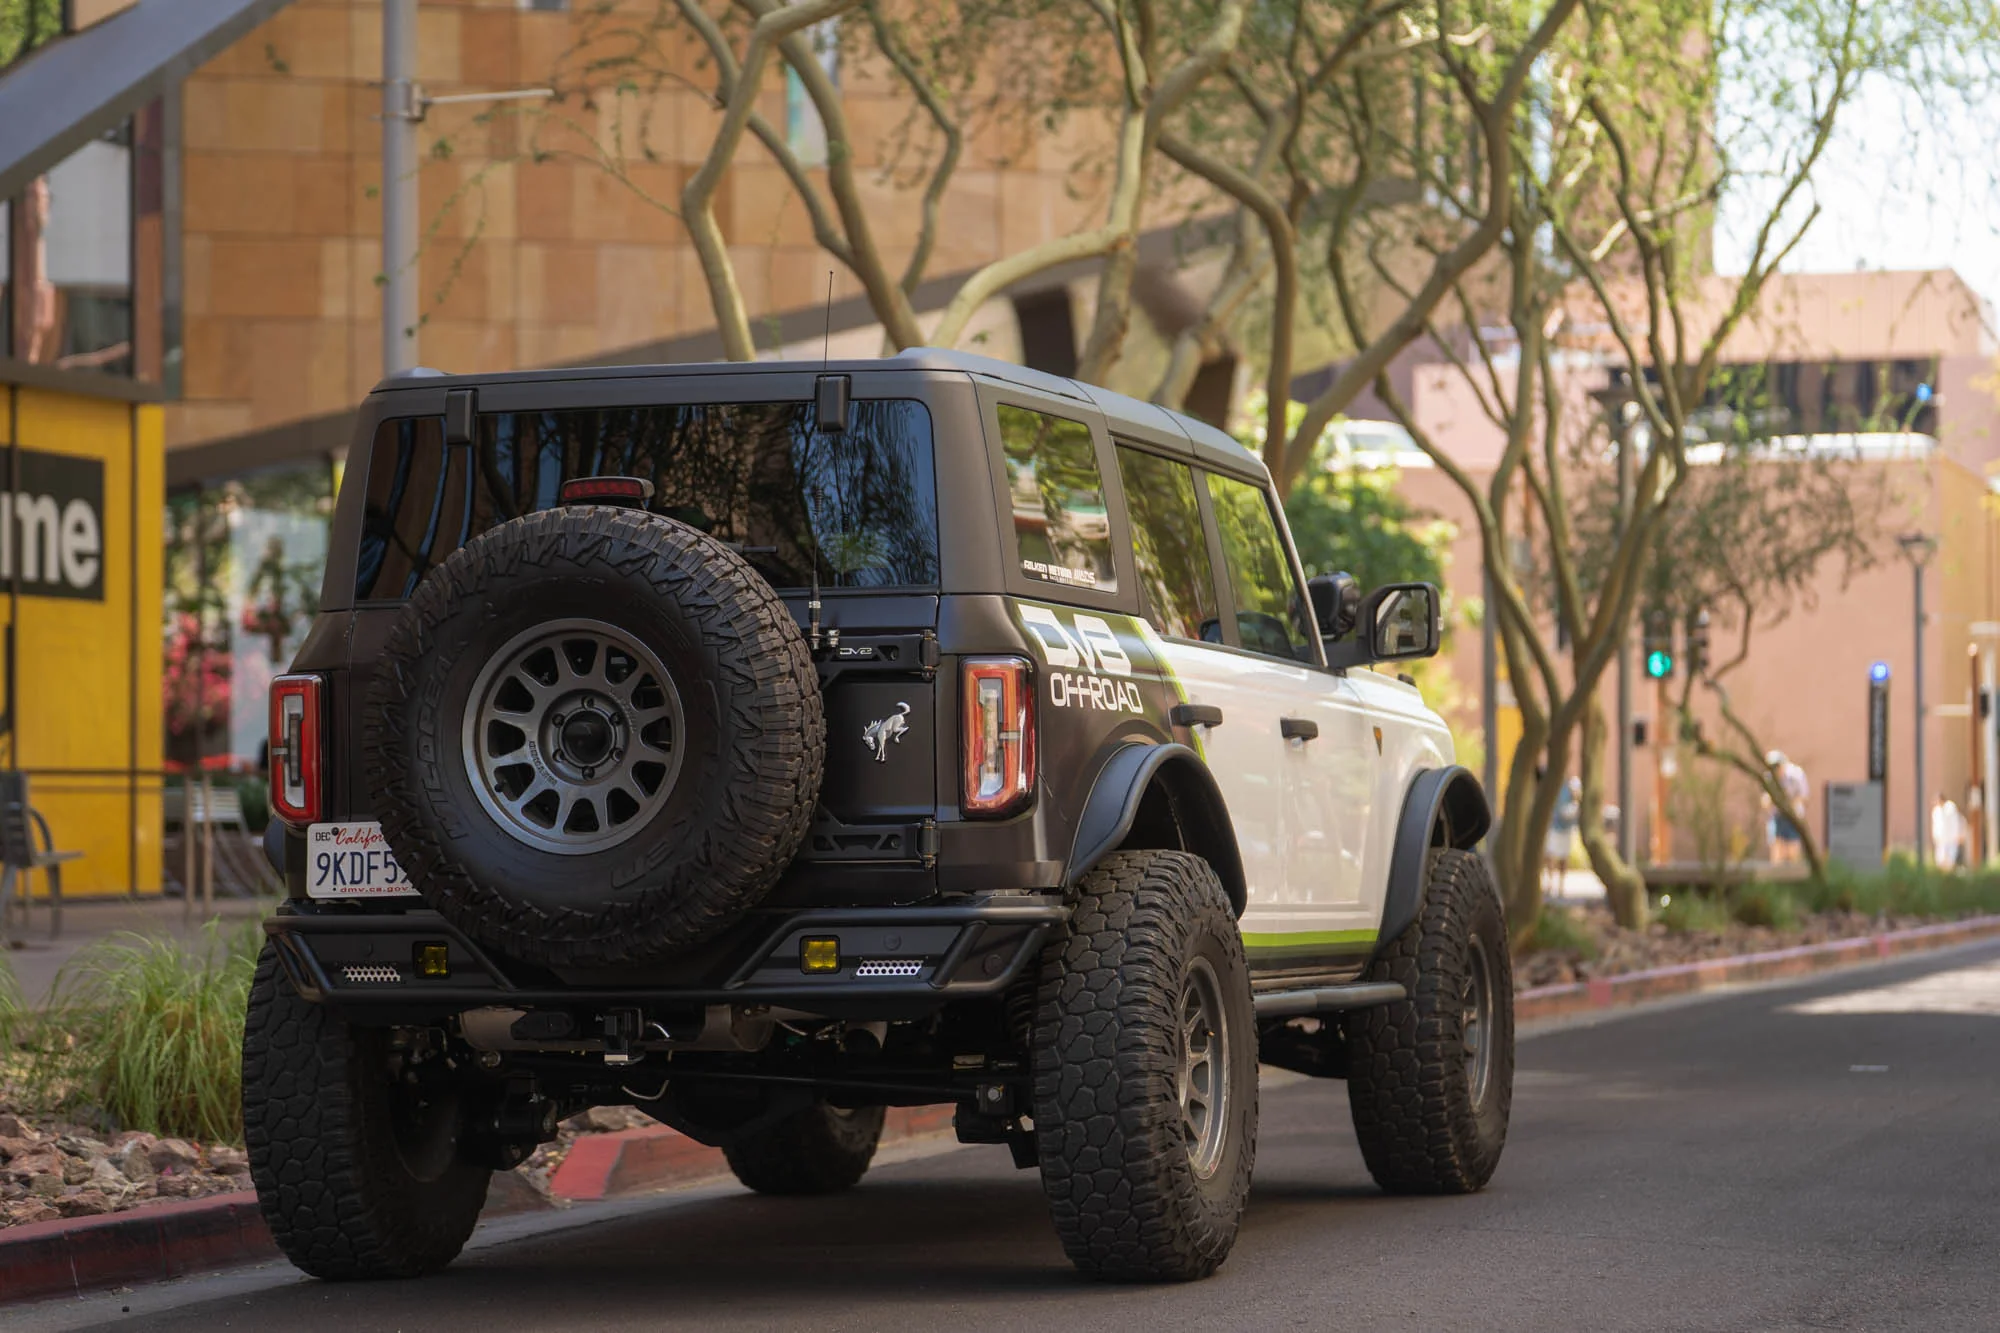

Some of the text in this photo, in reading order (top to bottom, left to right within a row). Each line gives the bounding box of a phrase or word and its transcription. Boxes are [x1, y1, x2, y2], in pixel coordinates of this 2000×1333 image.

[1018, 603, 1132, 676] DV8
[1050, 672, 1144, 714] OFFROAD
[315, 831, 331, 841] DEC
[316, 850, 408, 886] 9KDF5
